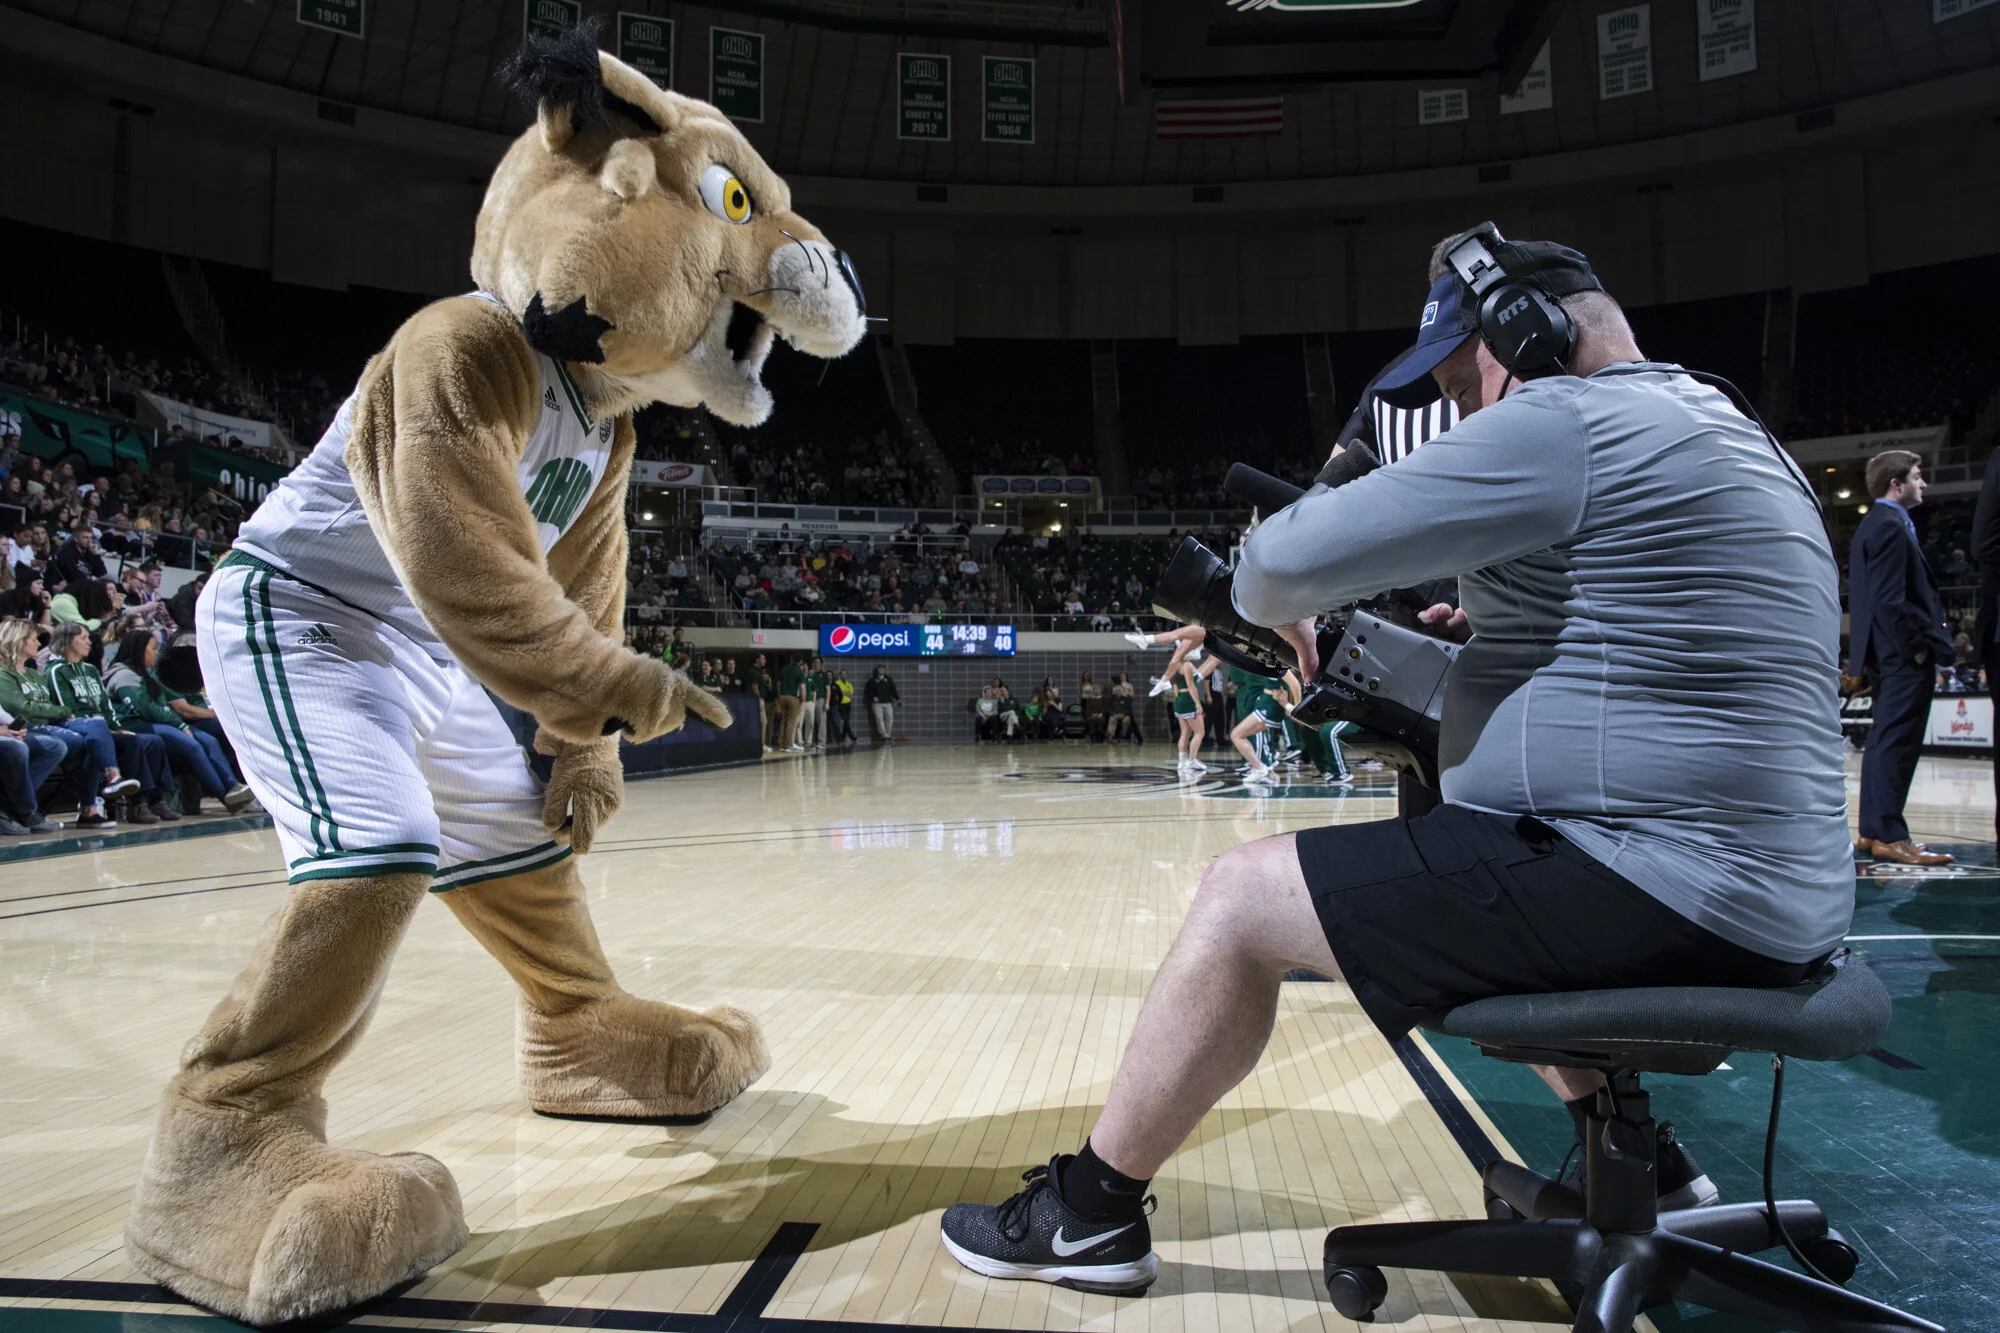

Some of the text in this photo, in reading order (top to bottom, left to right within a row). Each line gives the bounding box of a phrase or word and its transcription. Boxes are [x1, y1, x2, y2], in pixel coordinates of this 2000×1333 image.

[315, 7, 347, 26] 1941
[1608, 13, 1639, 35] OHIO
[631, 22, 661, 45] OHIO
[722, 36, 752, 58] OHIO
[727, 70, 746, 79] NCAA
[909, 60, 938, 80] OHIO
[993, 63, 1023, 84] OHIO
[903, 99, 945, 109] TOURNAMENT
[915, 93, 932, 101] NCAA
[1000, 95, 1016, 103] NCAA
[987, 101, 1030, 112] TOURNAMENT
[905, 110, 930, 120] SWEET
[986, 112, 1030, 123] ELITE EIGHT
[911, 122, 937, 134] 2012
[996, 124, 1021, 136] 1964
[1497, 295, 1529, 326] RTS
[524, 457, 592, 536] OHIO
[297, 634, 338, 646] adidas
[858, 629, 908, 650] pepsi
[923, 625, 942, 634] OHIO
[951, 625, 987, 641] 14:39
[926, 634, 1012, 651] 44 40
[963, 642, 976, 653] :10
